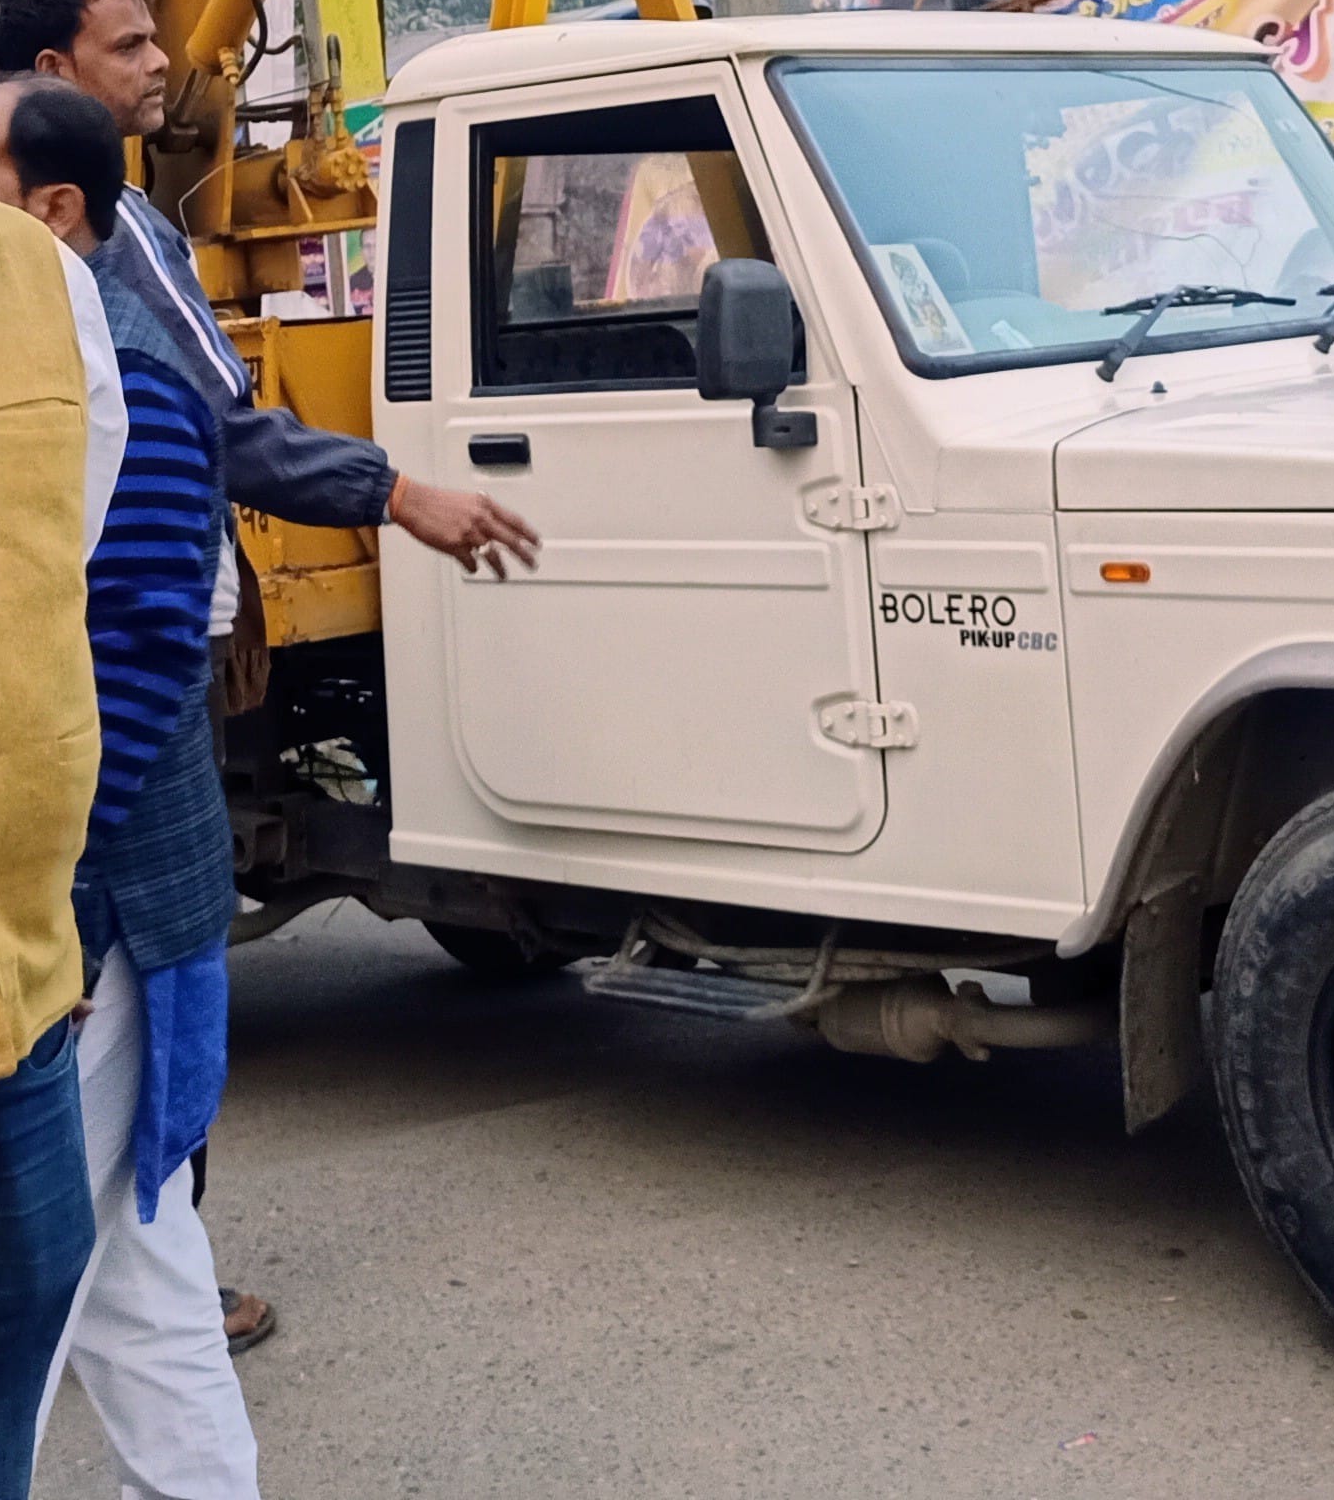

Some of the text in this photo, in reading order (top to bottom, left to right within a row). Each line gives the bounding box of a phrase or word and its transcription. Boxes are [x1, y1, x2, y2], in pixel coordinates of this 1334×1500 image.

[879, 593, 1016, 628] BOLERO
[960, 629, 1058, 651] PIK-UP CBC
